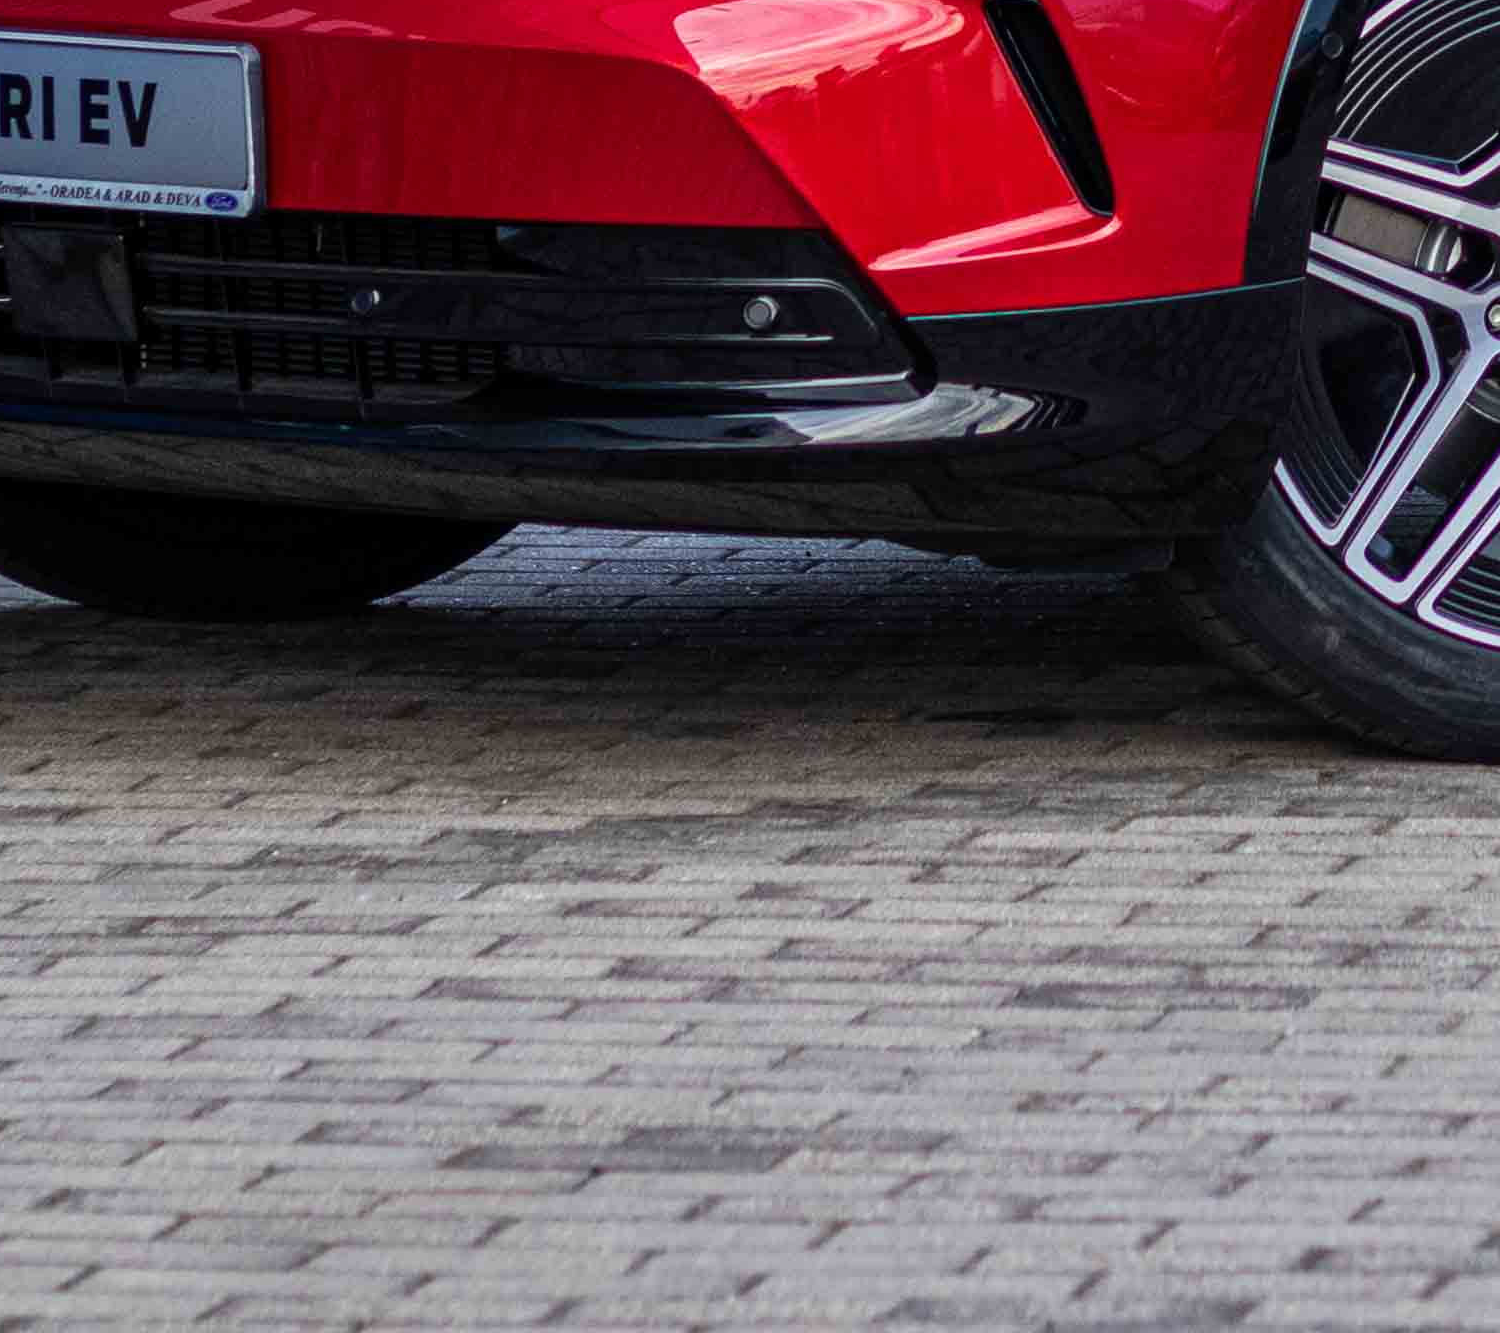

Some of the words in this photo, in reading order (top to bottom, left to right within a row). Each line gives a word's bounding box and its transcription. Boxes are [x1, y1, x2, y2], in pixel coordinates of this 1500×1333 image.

[79, 78, 158, 148] EV
[50, 184, 101, 201] ORADEA
[113, 189, 150, 204] ARAD
[165, 191, 201, 207] DEVA
